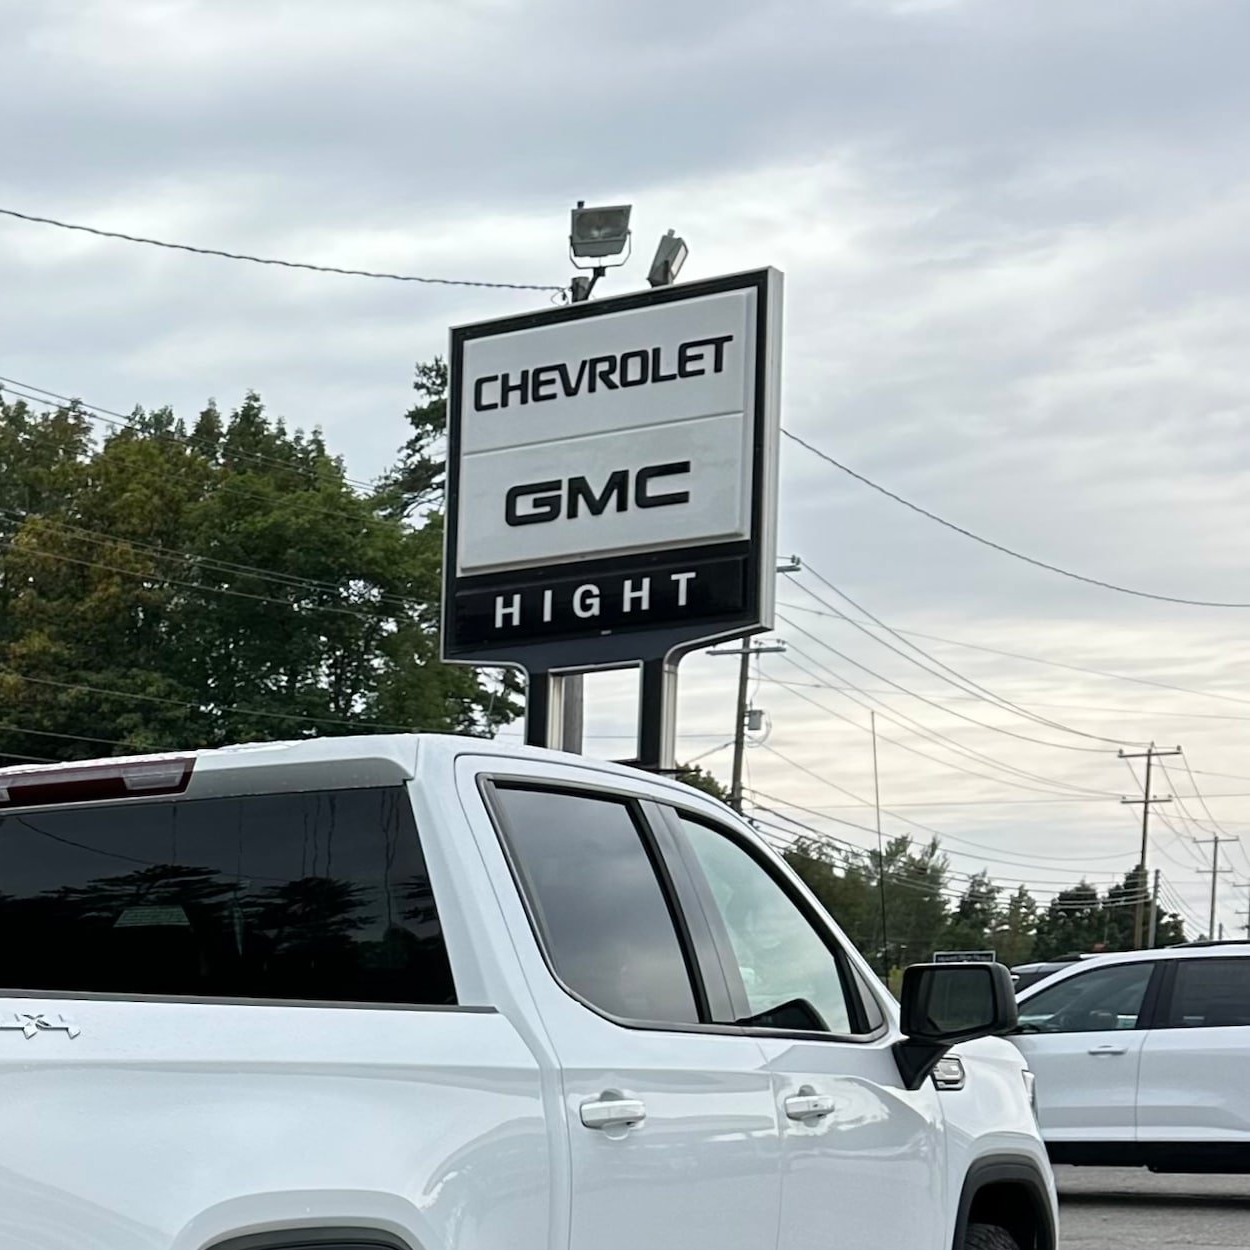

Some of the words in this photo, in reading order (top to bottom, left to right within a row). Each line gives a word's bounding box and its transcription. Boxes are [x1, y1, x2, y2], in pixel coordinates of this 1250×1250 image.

[473, 334, 734, 412] CHEVROLET
[505, 460, 691, 528] GMC
[494, 571, 697, 629] HIGHT
